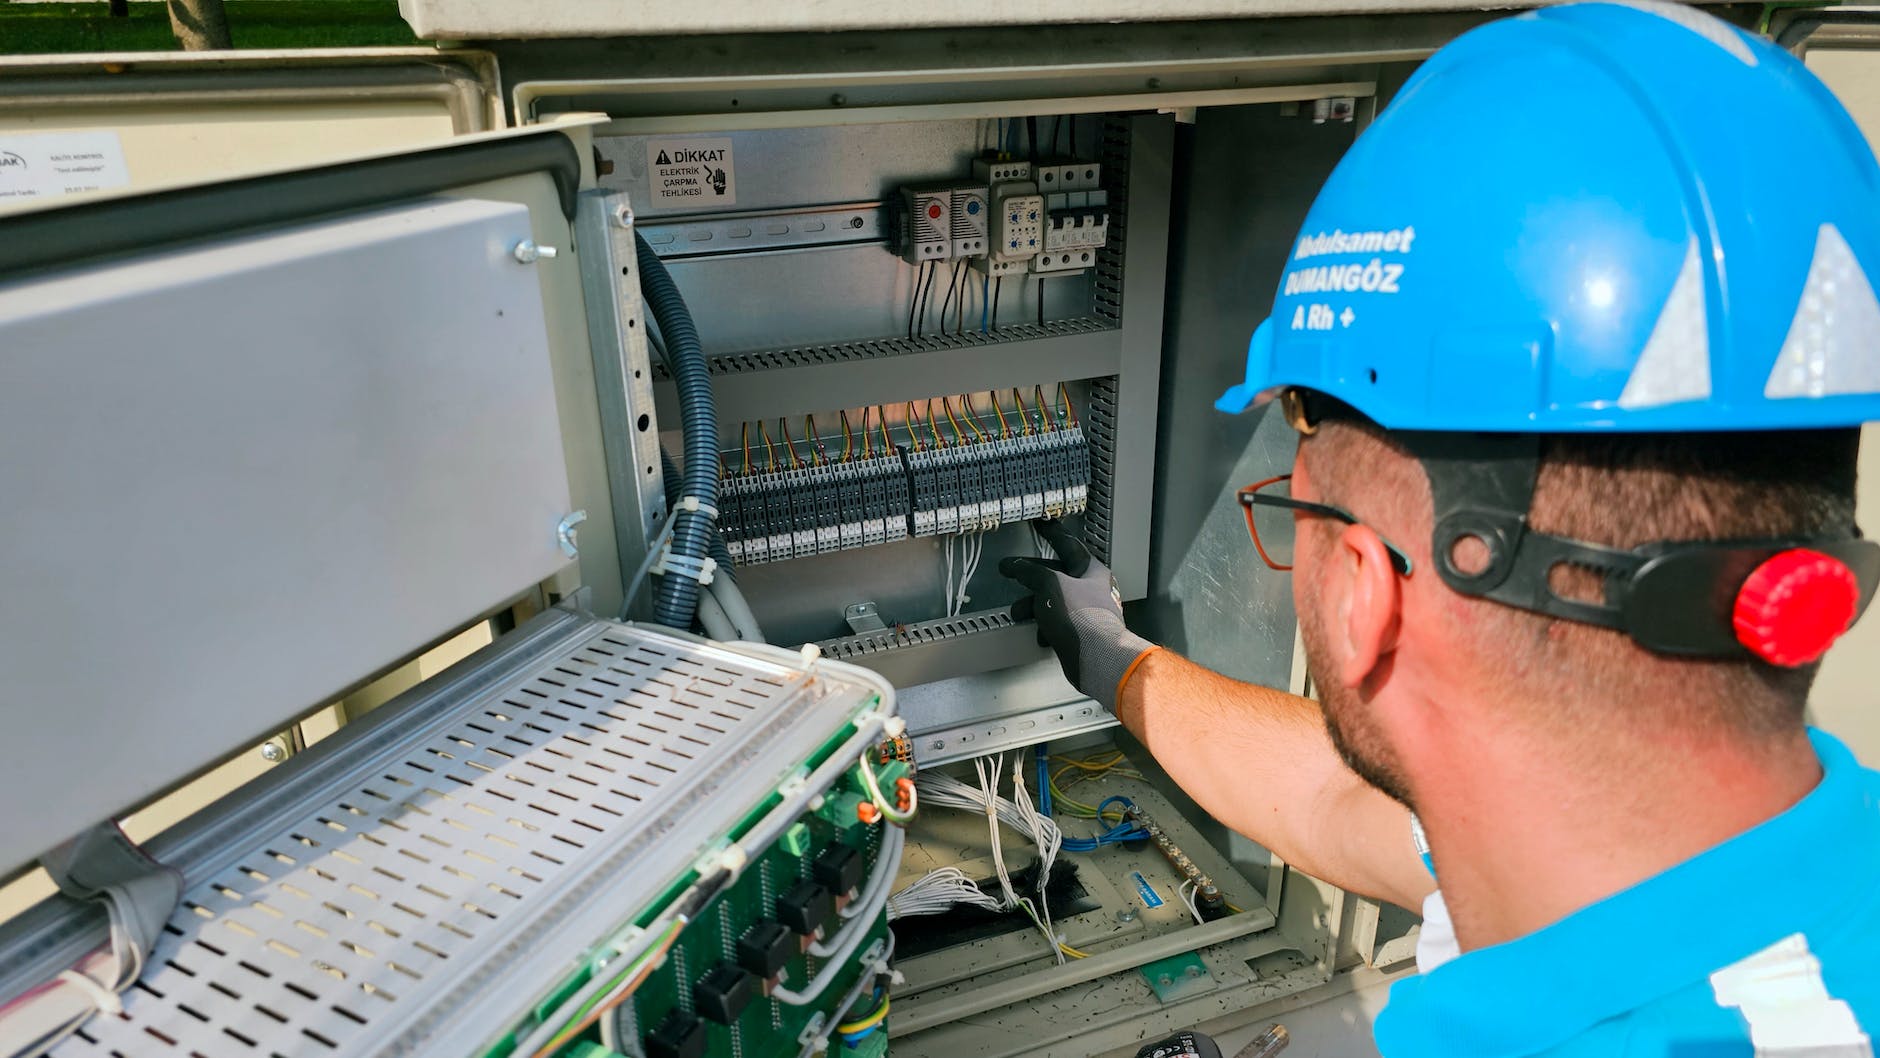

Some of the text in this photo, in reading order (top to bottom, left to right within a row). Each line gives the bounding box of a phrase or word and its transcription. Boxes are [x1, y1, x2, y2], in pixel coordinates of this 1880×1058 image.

[674, 148, 726, 163] DİKKAT
[660, 166, 700, 176] ELEKTRİK
[663, 178, 698, 187] ÇARPMA
[661, 187, 702, 197] TEHLİKESİ
[1291, 304, 1305, 330] A
[1307, 303, 1335, 330] Rh
